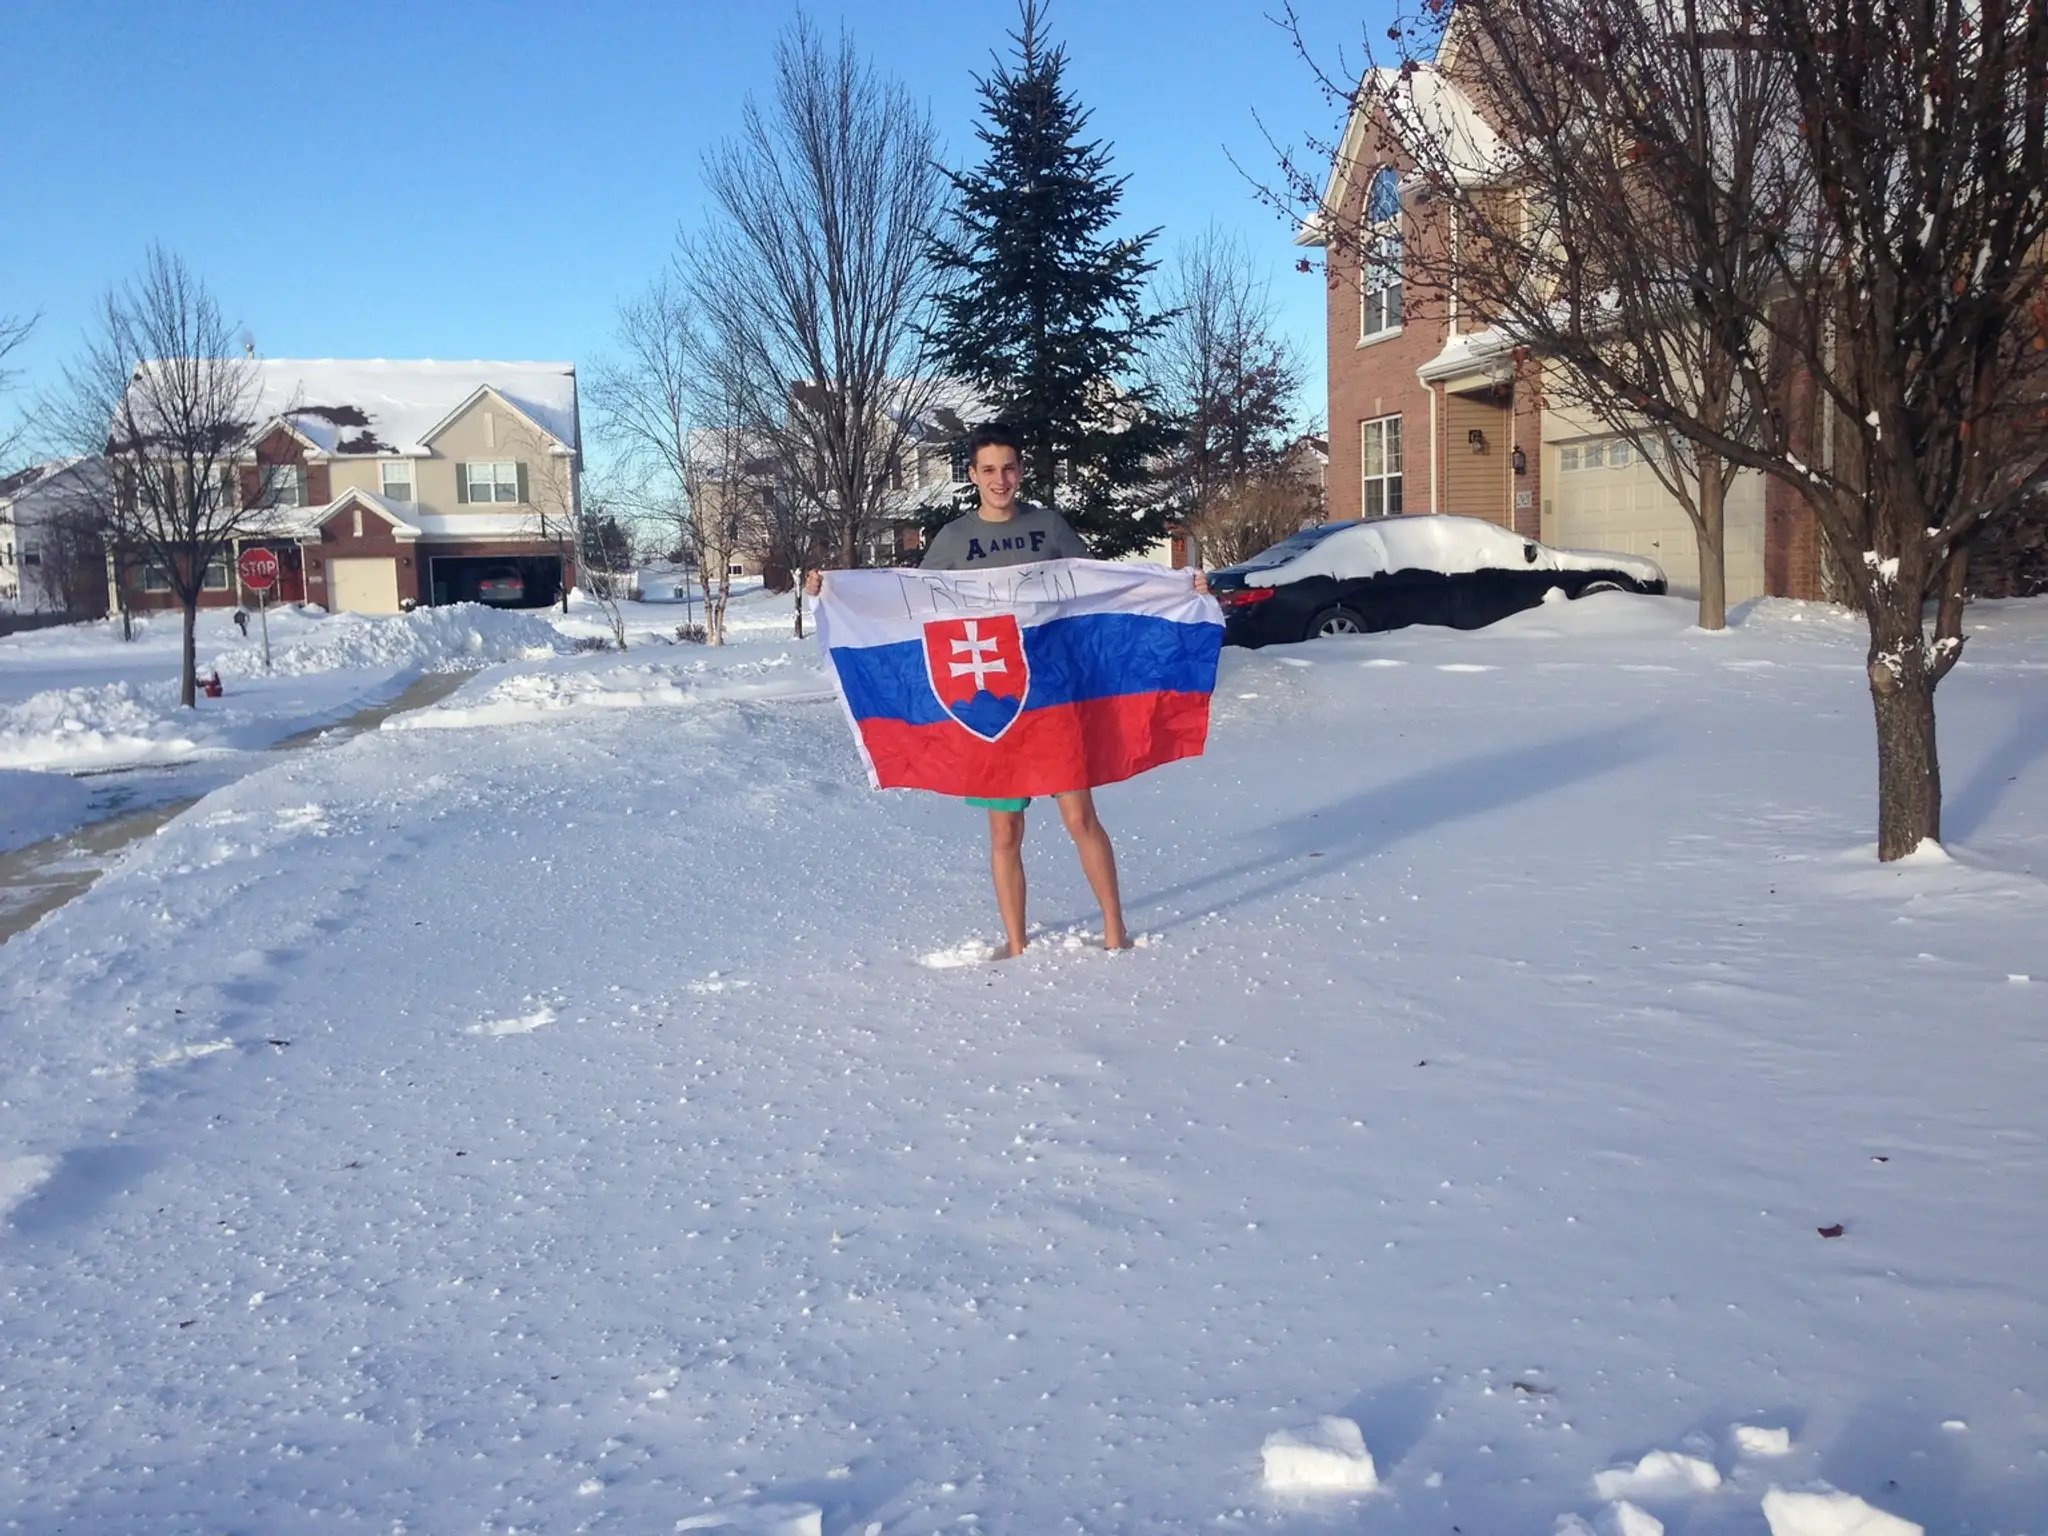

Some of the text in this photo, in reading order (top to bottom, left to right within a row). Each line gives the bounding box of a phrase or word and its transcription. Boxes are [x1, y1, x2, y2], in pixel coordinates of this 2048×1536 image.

[966, 530, 1046, 561] A AND F
[241, 560, 276, 577] STOP
